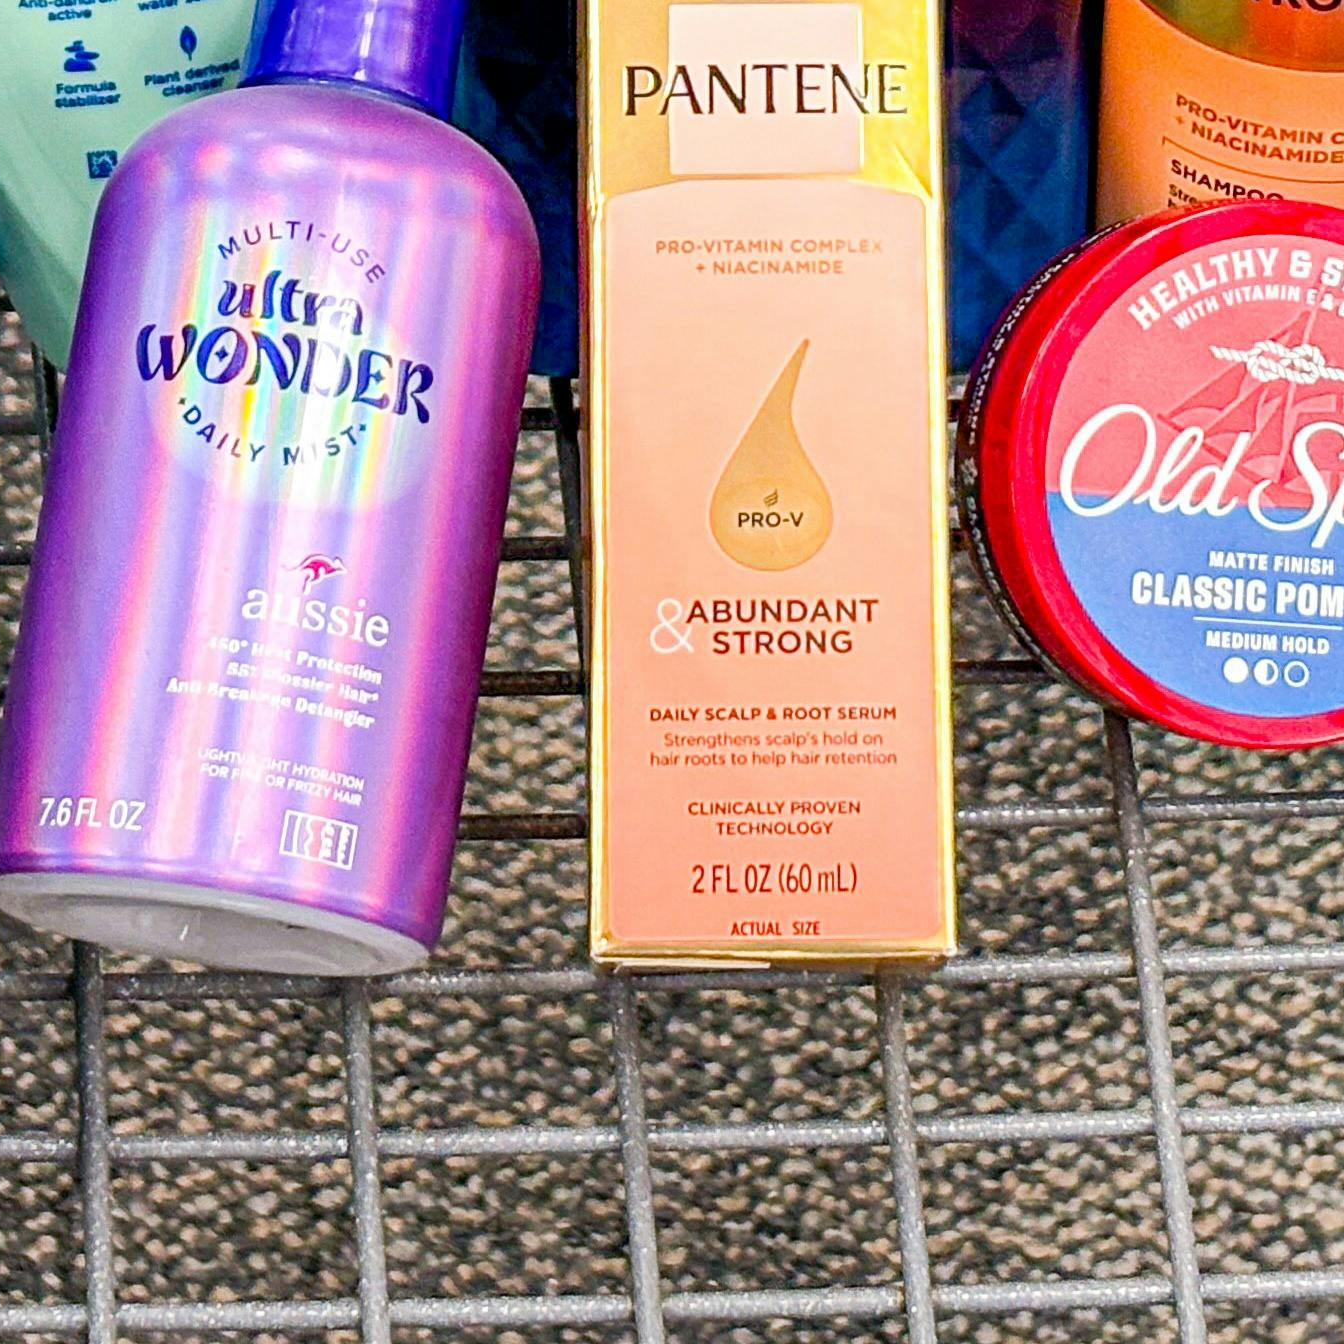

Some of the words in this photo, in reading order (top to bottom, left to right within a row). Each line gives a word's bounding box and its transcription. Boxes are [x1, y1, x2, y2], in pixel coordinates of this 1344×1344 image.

[48, 8, 92, 21] active
[56, 80, 117, 94] Formula
[162, 78, 225, 97] cleanser
[624, 63, 907, 116] PANTENE
[55, 93, 121, 108] stabilizer
[1175, 93, 1324, 145] PRO-VITAMIN
[1190, 121, 1344, 164] NIACINAMIDE
[218, 220, 386, 284] MULTI-USE
[656, 240, 783, 255] PRO-VITAMIN
[787, 240, 882, 253] COMPLEX
[713, 261, 844, 275] NIACINAMIDE
[1129, 247, 1280, 331] HEALTHY
[217, 269, 363, 336] ultra
[1173, 296, 1220, 331] WITH
[1222, 284, 1302, 311] VITAMIN
[136, 324, 434, 425] WONDER
[183, 404, 265, 463] DAILY
[1059, 403, 1256, 517] Old
[738, 512, 804, 528] PRO-V
[1209, 550, 1269, 571] MATTE
[1274, 555, 1335, 575] FINISH
[1131, 571, 1268, 613] CLASSIC
[241, 587, 390, 647] aussie
[650, 598, 694, 654] &
[686, 598, 879, 624] ABUNDANT
[712, 630, 853, 655] STRONG
[1205, 630, 1278, 652] MEDIUM
[1282, 633, 1330, 654] HOLD
[296, 651, 382, 685] Protection
[650, 708, 700, 722] DAILY
[705, 708, 761, 721] SCALP
[783, 708, 832, 720] ROOT
[838, 707, 896, 720] SERUM
[664, 732, 761, 750] Strengthens
[766, 732, 818, 748] scalp's
[822, 732, 858, 746] hold
[650, 752, 679, 766] hair
[684, 754, 726, 766] roots
[752, 752, 786, 767] help
[790, 752, 820, 764] hair
[825, 752, 898, 764] retention
[292, 764, 365, 790] HYDRATION
[39, 797, 72, 826] 7.6
[109, 799, 145, 831] OZ
[688, 802, 786, 816] CLINICALLY
[790, 801, 861, 814] PROVEN
[716, 822, 834, 836] TECHNOLOGY
[744, 864, 772, 893] OZ
[778, 863, 812, 894] (60
[817, 862, 858, 893] mL)
[730, 922, 782, 936] ACTUAL
[792, 921, 821, 934] SIZE
